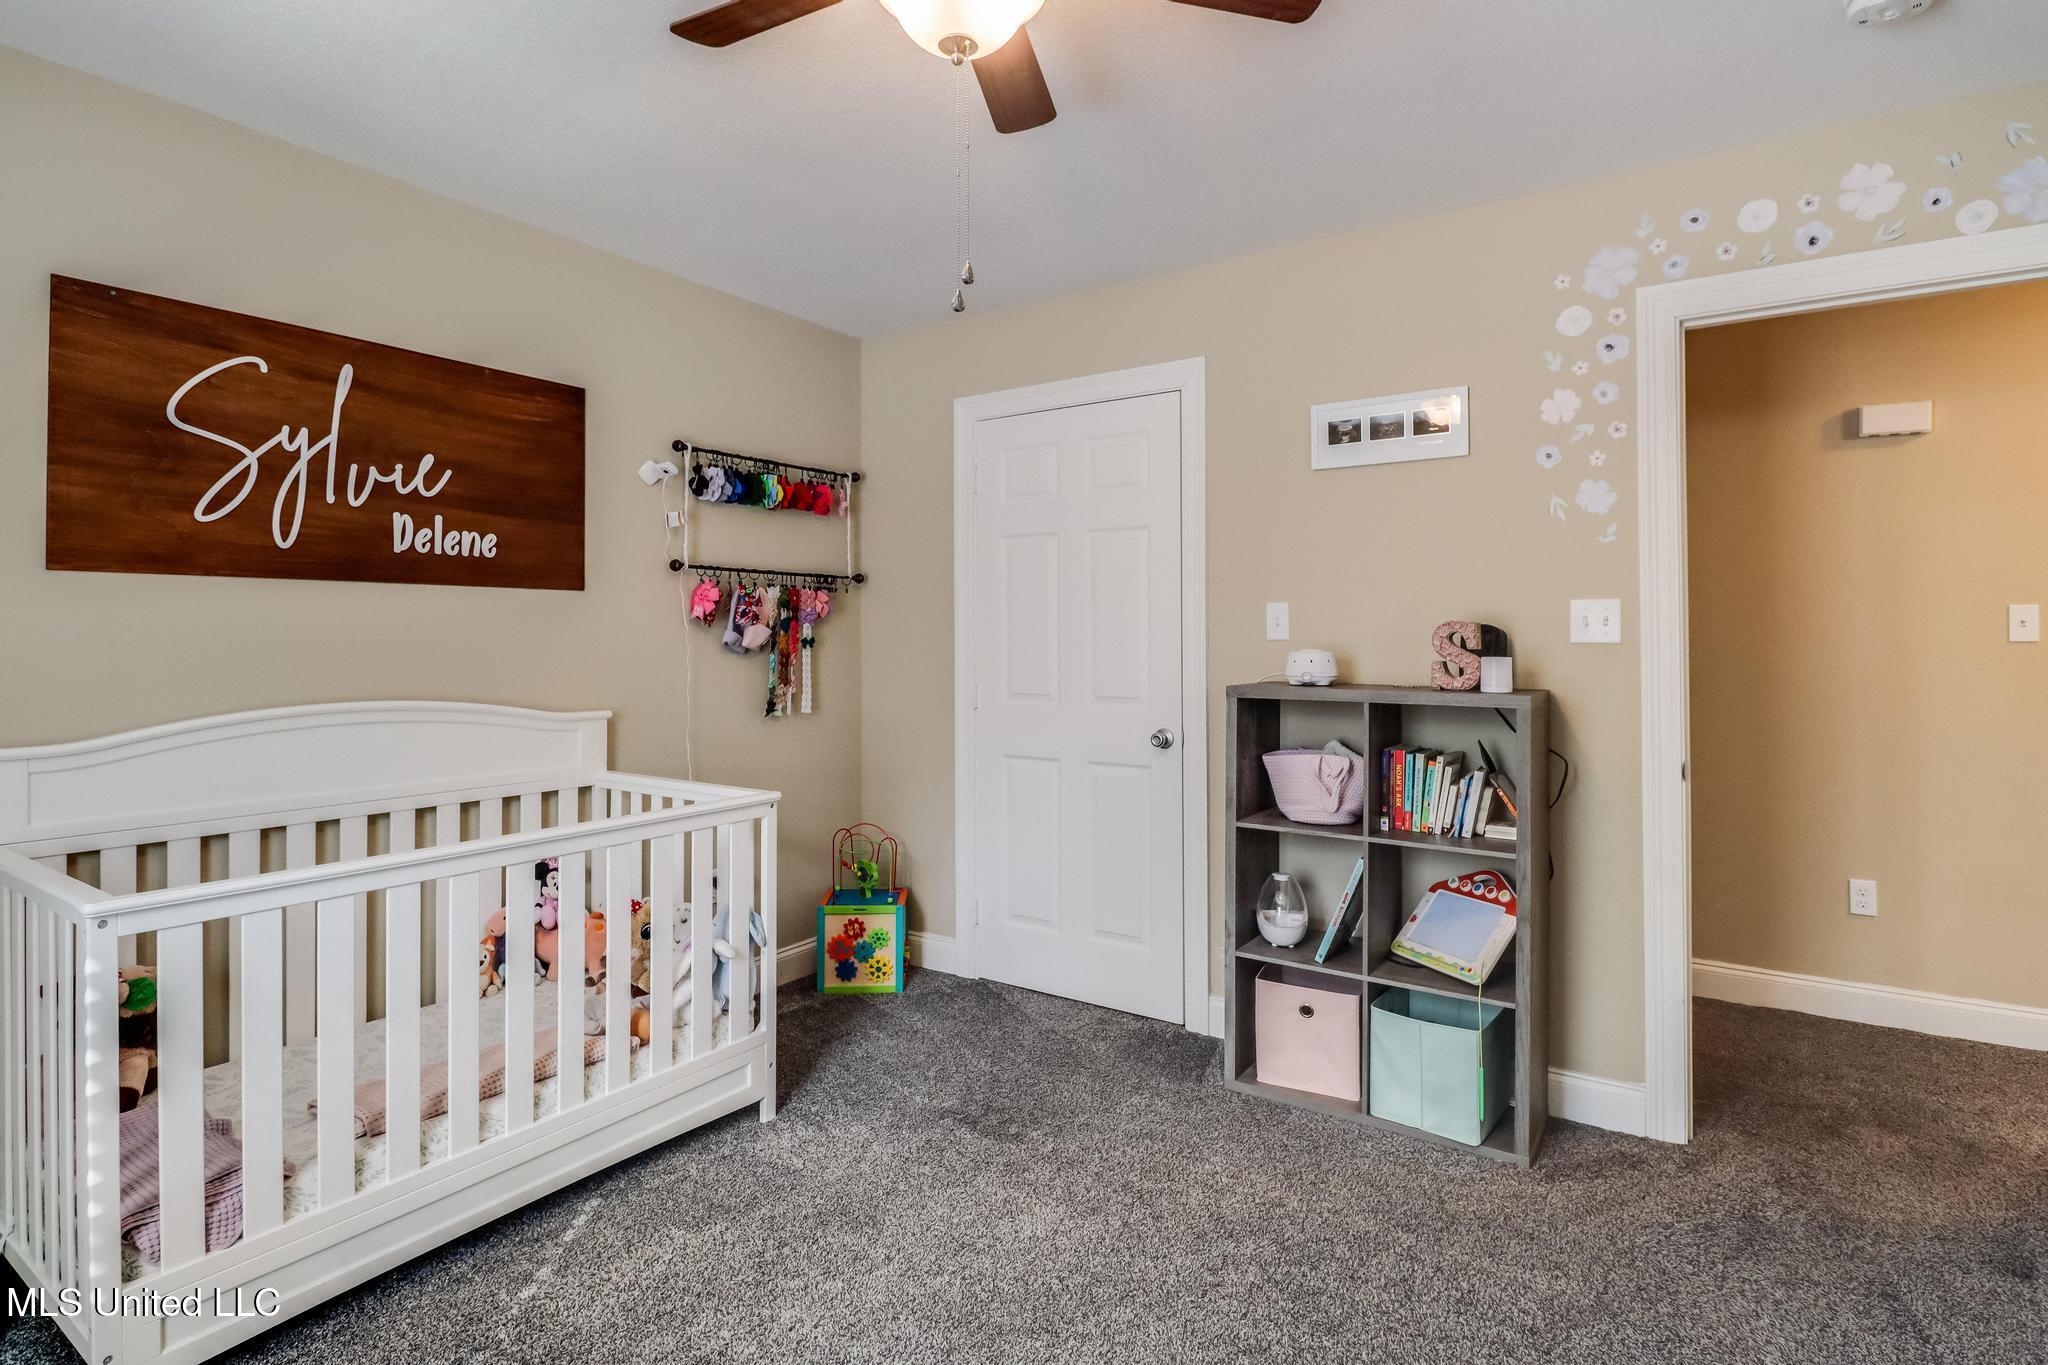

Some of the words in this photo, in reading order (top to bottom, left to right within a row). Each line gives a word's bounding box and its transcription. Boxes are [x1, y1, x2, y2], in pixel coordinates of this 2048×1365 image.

[166, 356, 452, 550] Sylvie
[392, 512, 498, 558] Delene
[1431, 620, 1481, 691] S
